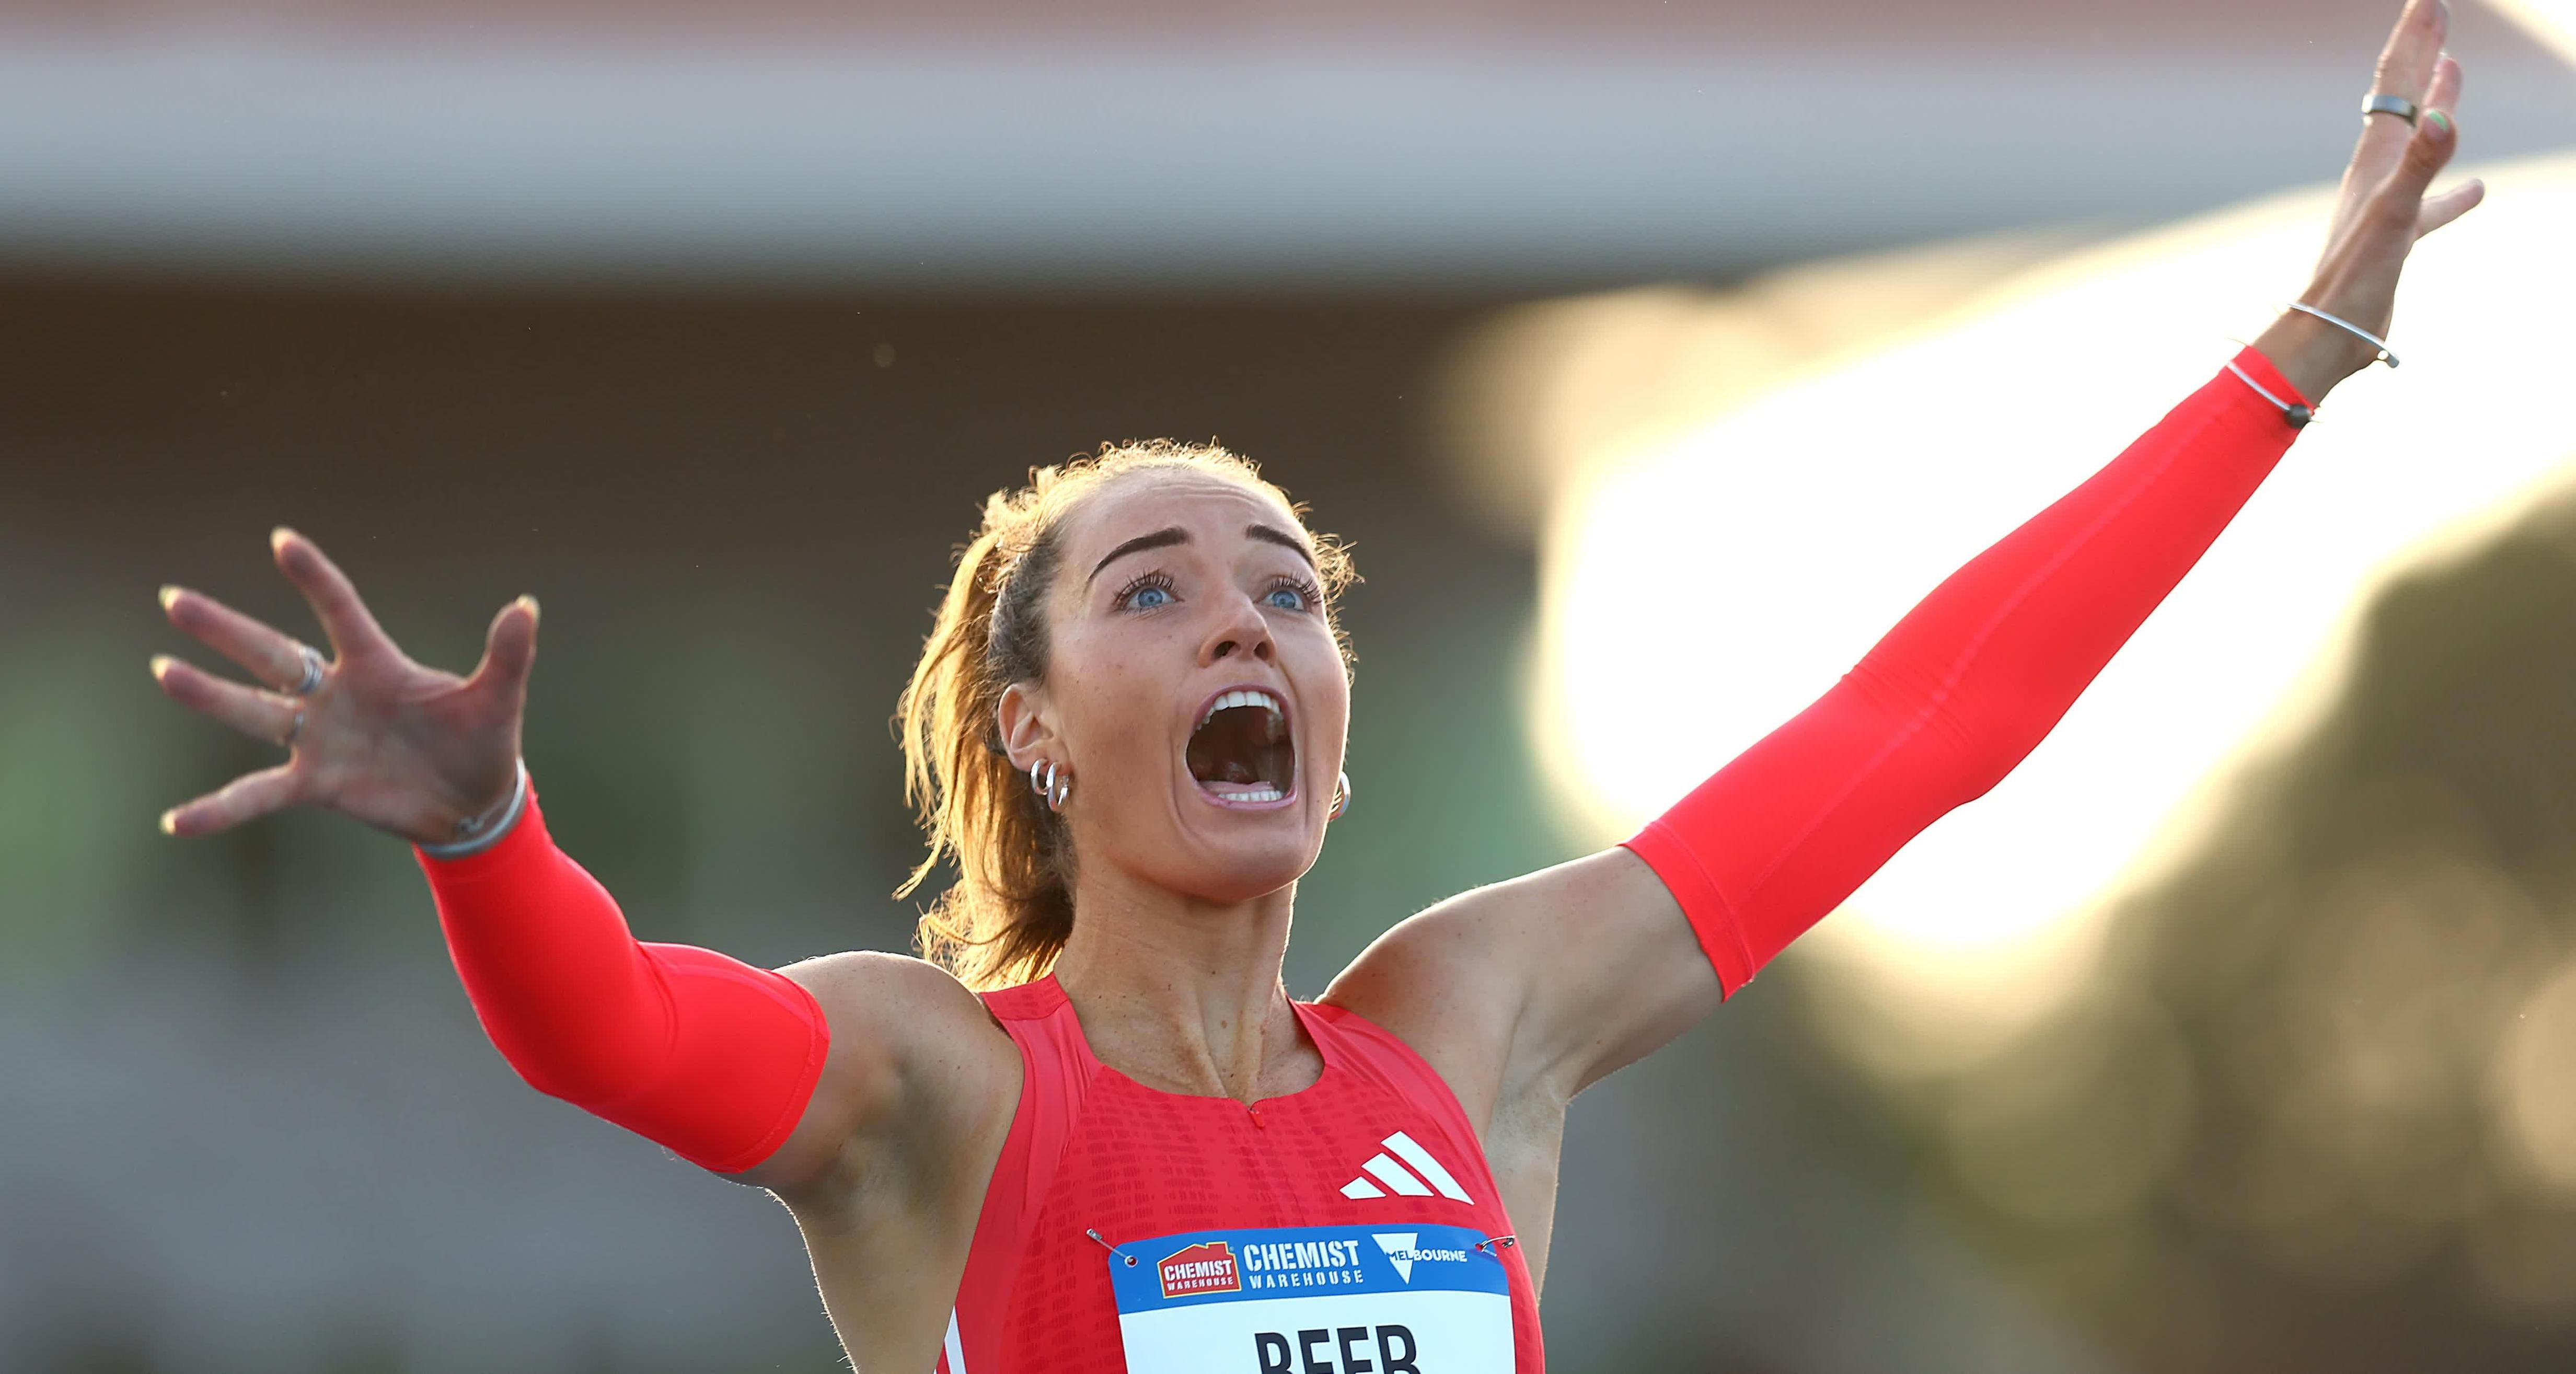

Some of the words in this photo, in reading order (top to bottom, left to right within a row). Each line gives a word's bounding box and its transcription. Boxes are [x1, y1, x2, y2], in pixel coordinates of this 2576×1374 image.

[1243, 1240, 1359, 1272] CHEMIST
[1385, 1249, 1468, 1262] MELBOURNE
[1164, 1260, 1232, 1281] CHEMIST
[1249, 1269, 1364, 1289] WAREHOUSE
[1167, 1277, 1233, 1291] WAREHOUSE
